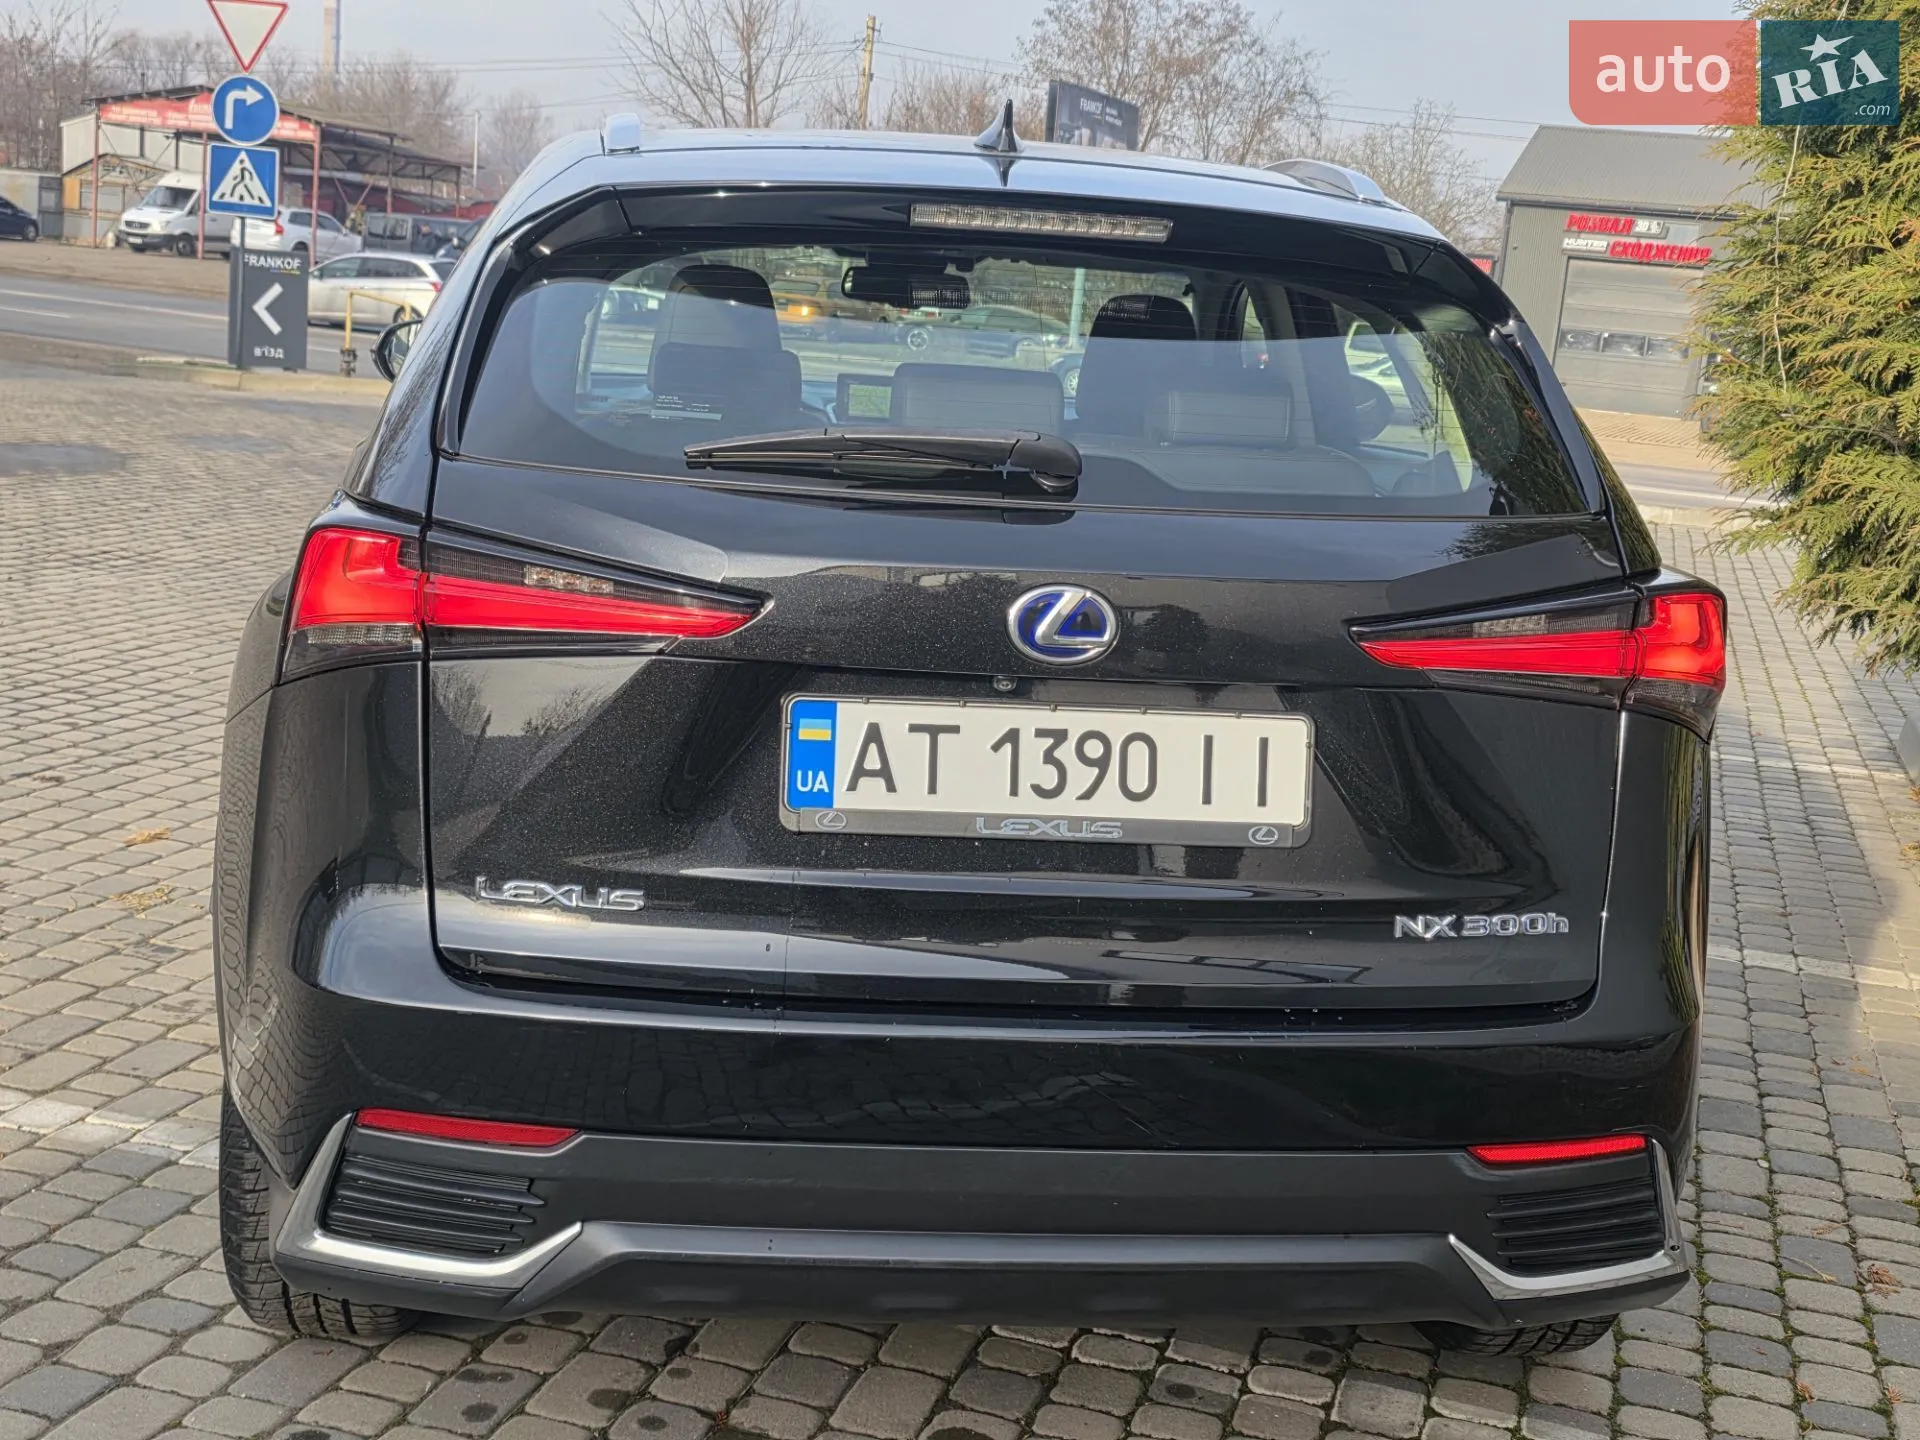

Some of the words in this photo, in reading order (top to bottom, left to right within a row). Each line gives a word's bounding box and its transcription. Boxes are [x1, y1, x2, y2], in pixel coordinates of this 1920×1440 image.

[1563, 237, 1608, 251] HUNTER
[845, 721, 961, 796] AT
[989, 727, 1158, 802] 1390
[796, 769, 830, 793] UA
[976, 816, 1123, 839] LEXUS
[475, 874, 646, 912] LEXUS
[1393, 914, 1458, 940] NX
[1461, 911, 1570, 937] 300h
